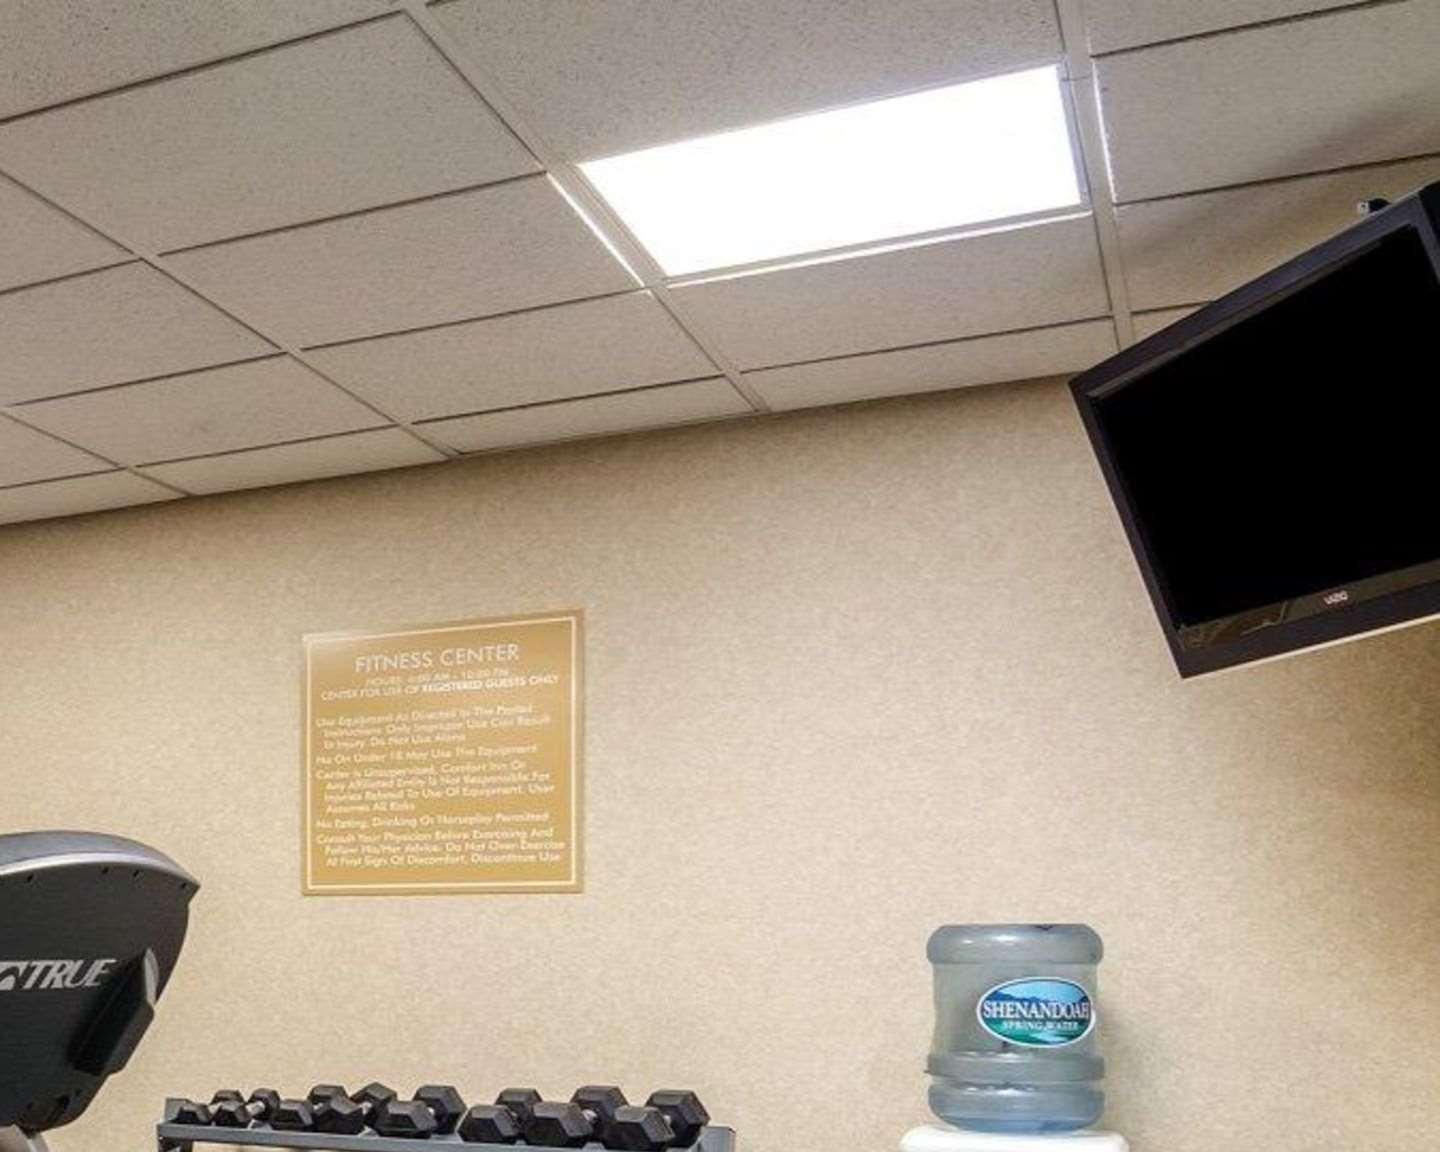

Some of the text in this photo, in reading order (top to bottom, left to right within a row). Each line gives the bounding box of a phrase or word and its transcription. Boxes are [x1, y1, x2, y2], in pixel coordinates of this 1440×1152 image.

[355, 643, 519, 672] FITNESS CENTER
[23, 958, 116, 989] TRUE
[983, 1001, 1089, 1019] SHENANDOAH
